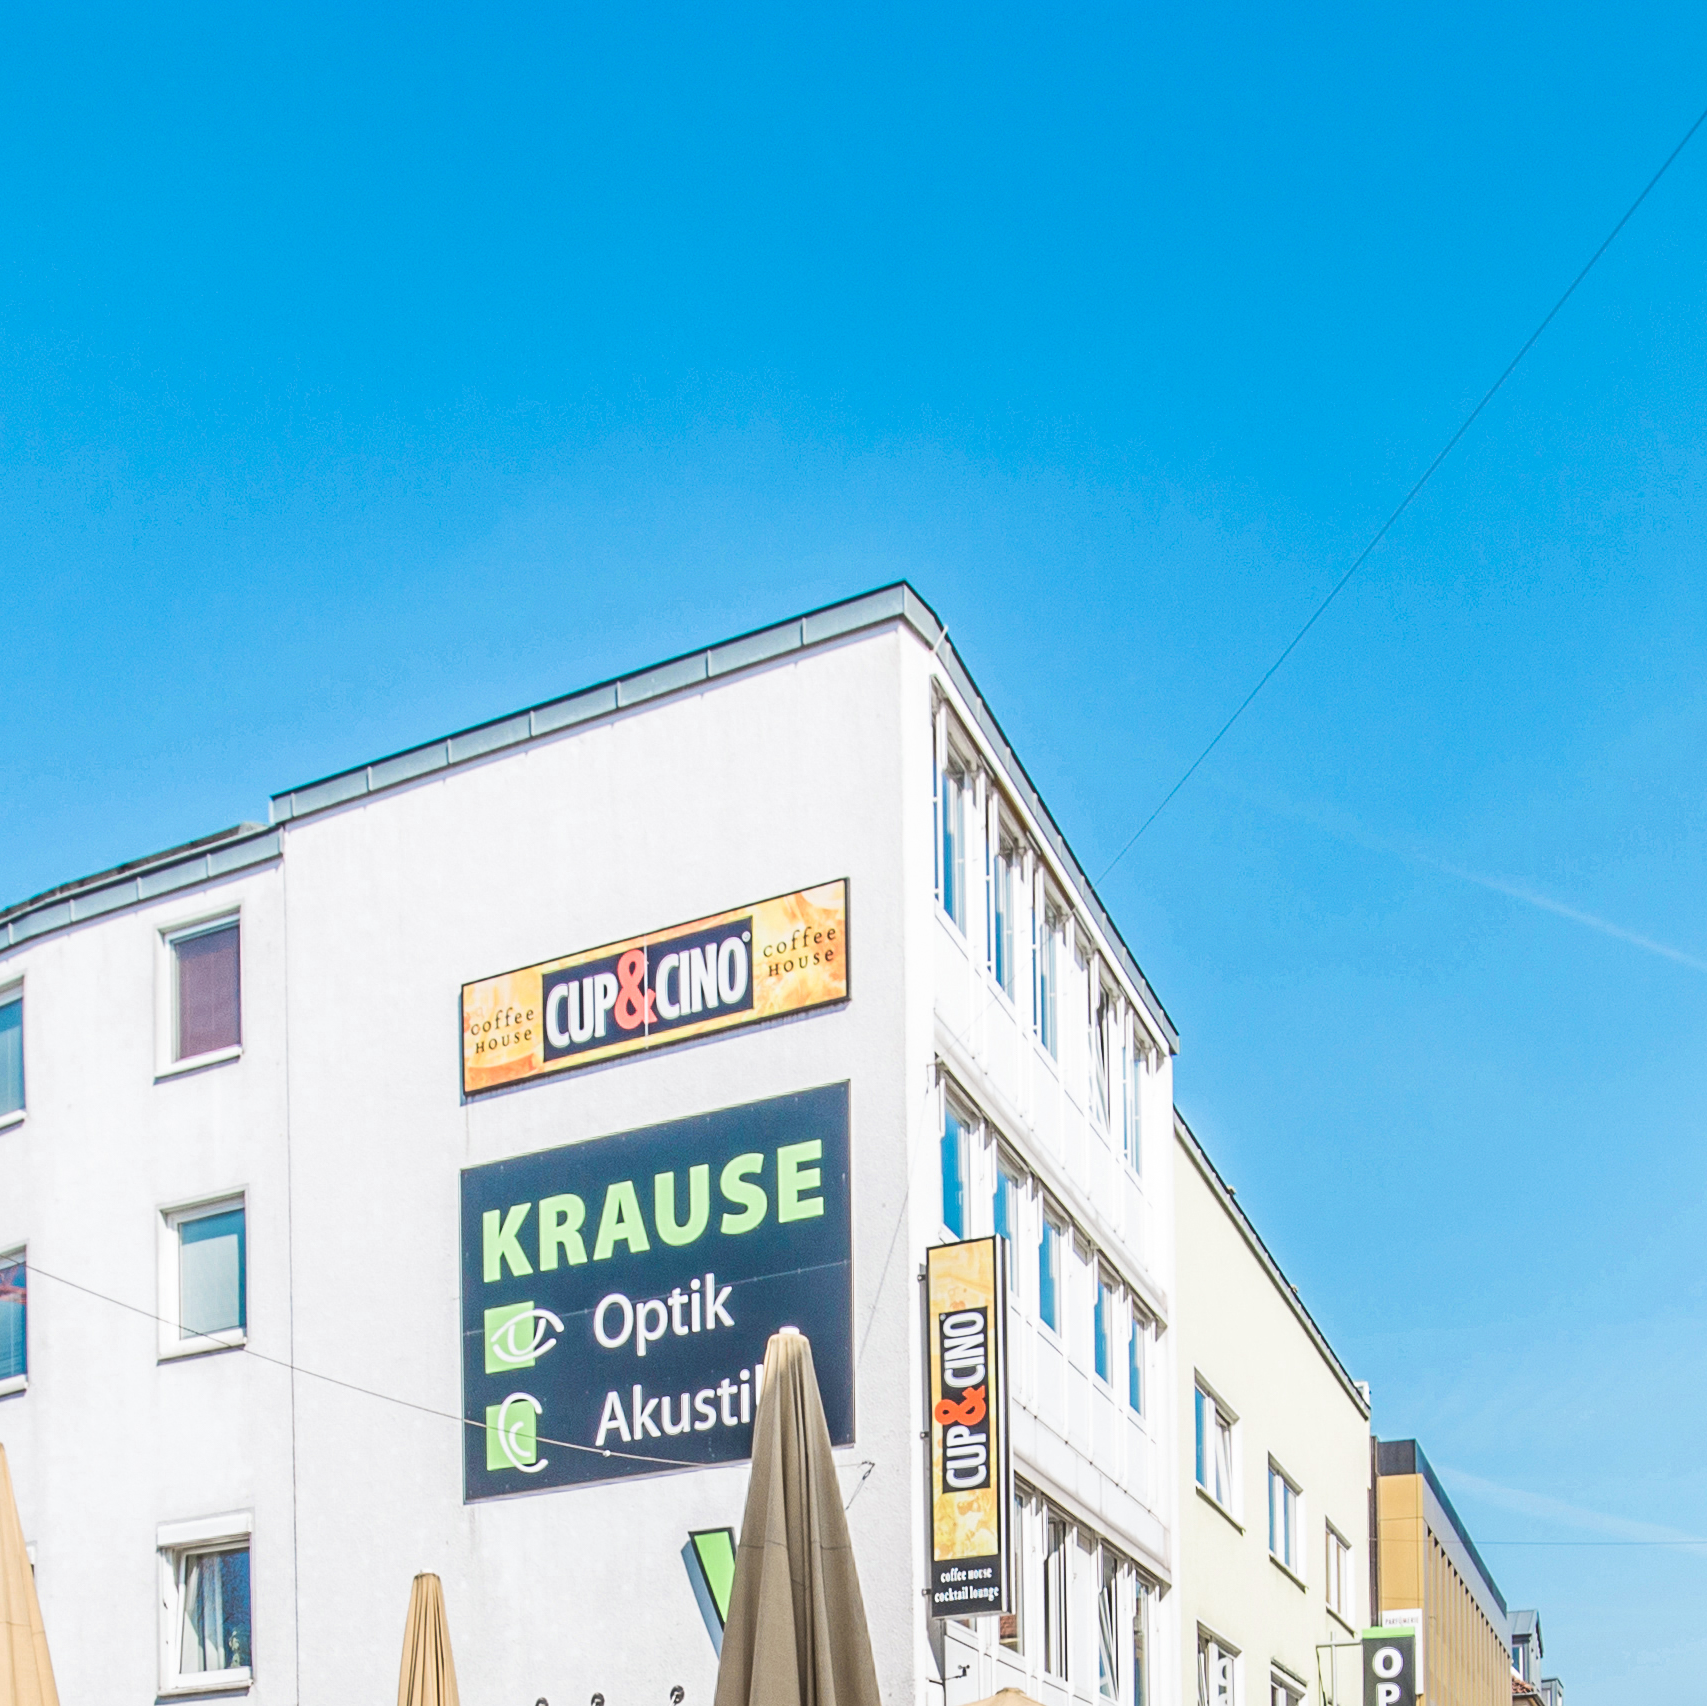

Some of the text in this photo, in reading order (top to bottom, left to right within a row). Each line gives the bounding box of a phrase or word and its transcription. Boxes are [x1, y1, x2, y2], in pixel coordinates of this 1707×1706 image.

[763, 925, 836, 958] coffee
[545, 929, 752, 1049] CUP&CINO
[470, 1007, 535, 1036] coffee
[481, 1138, 825, 1283] KRAUSE
[593, 1272, 735, 1357] Optik
[934, 1310, 988, 1489] CUP&CINO
[934, 1586, 1000, 1603] cocktail lounge
[940, 1567, 967, 1583] coffee
